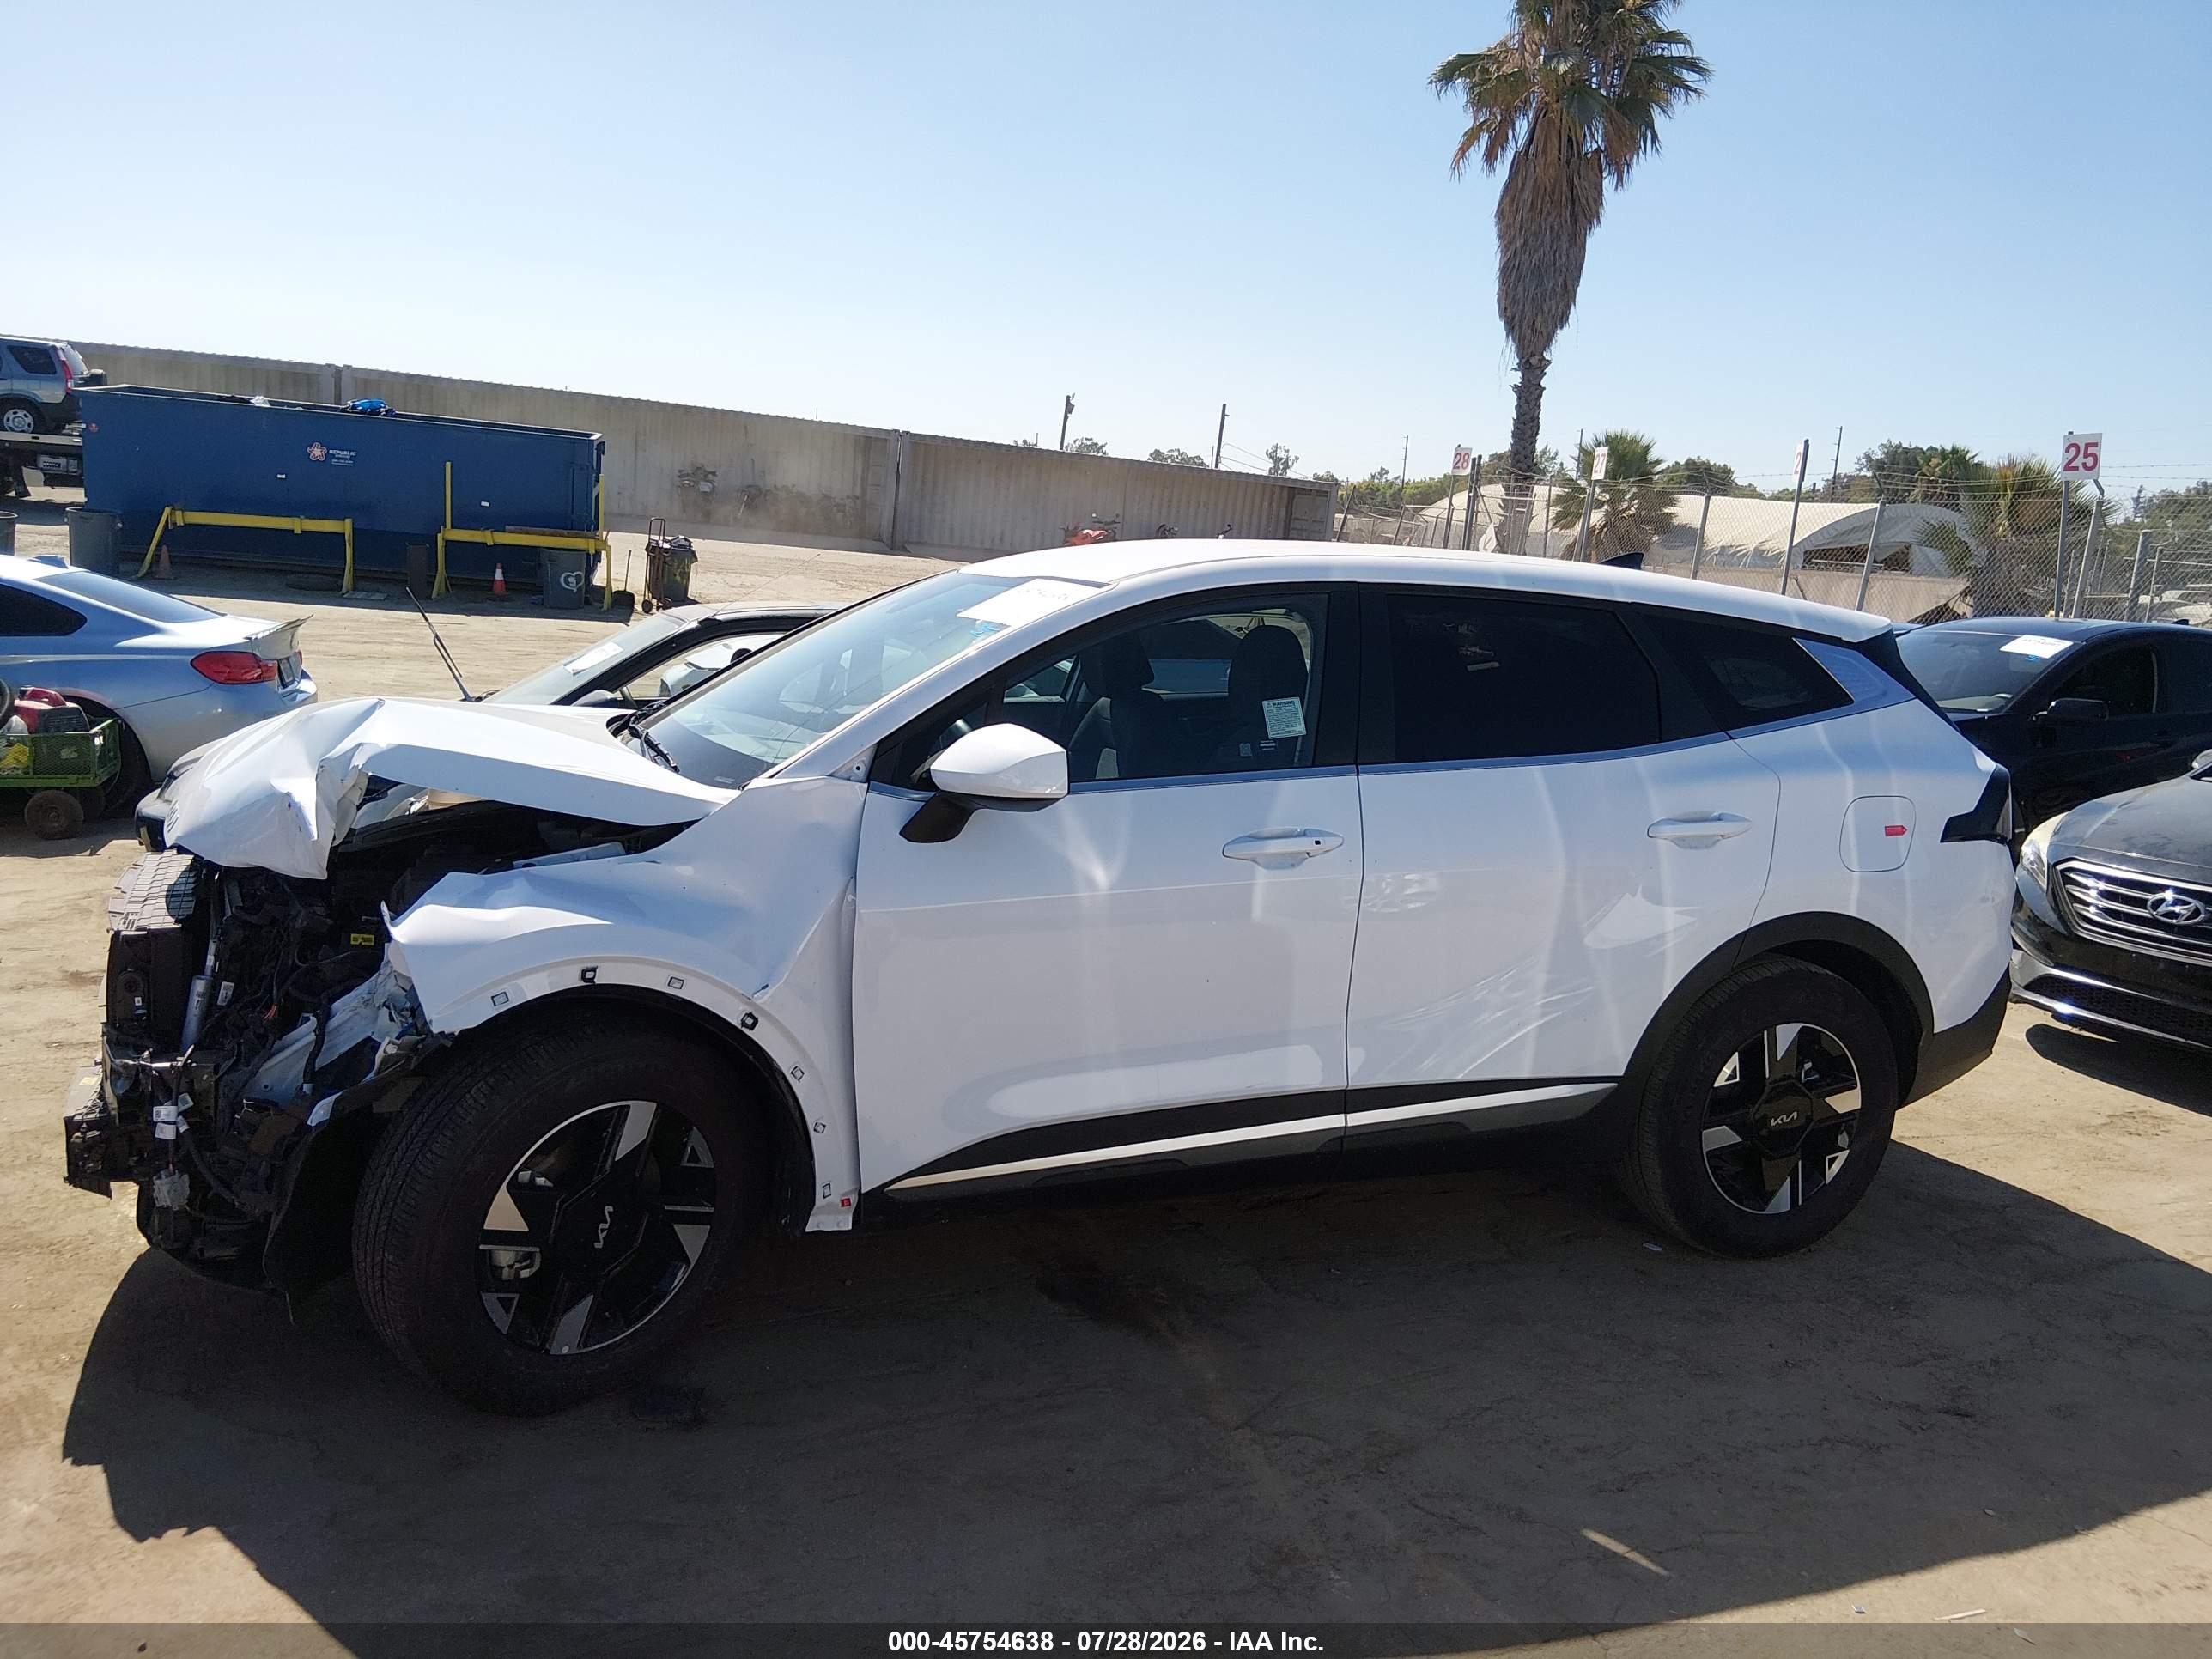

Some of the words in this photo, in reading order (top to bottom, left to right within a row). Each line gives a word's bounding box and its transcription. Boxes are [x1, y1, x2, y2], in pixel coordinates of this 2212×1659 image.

[1452, 452, 1470, 470] 28
[1594, 453, 1607, 474] 27
[2063, 441, 2099, 471] 25
